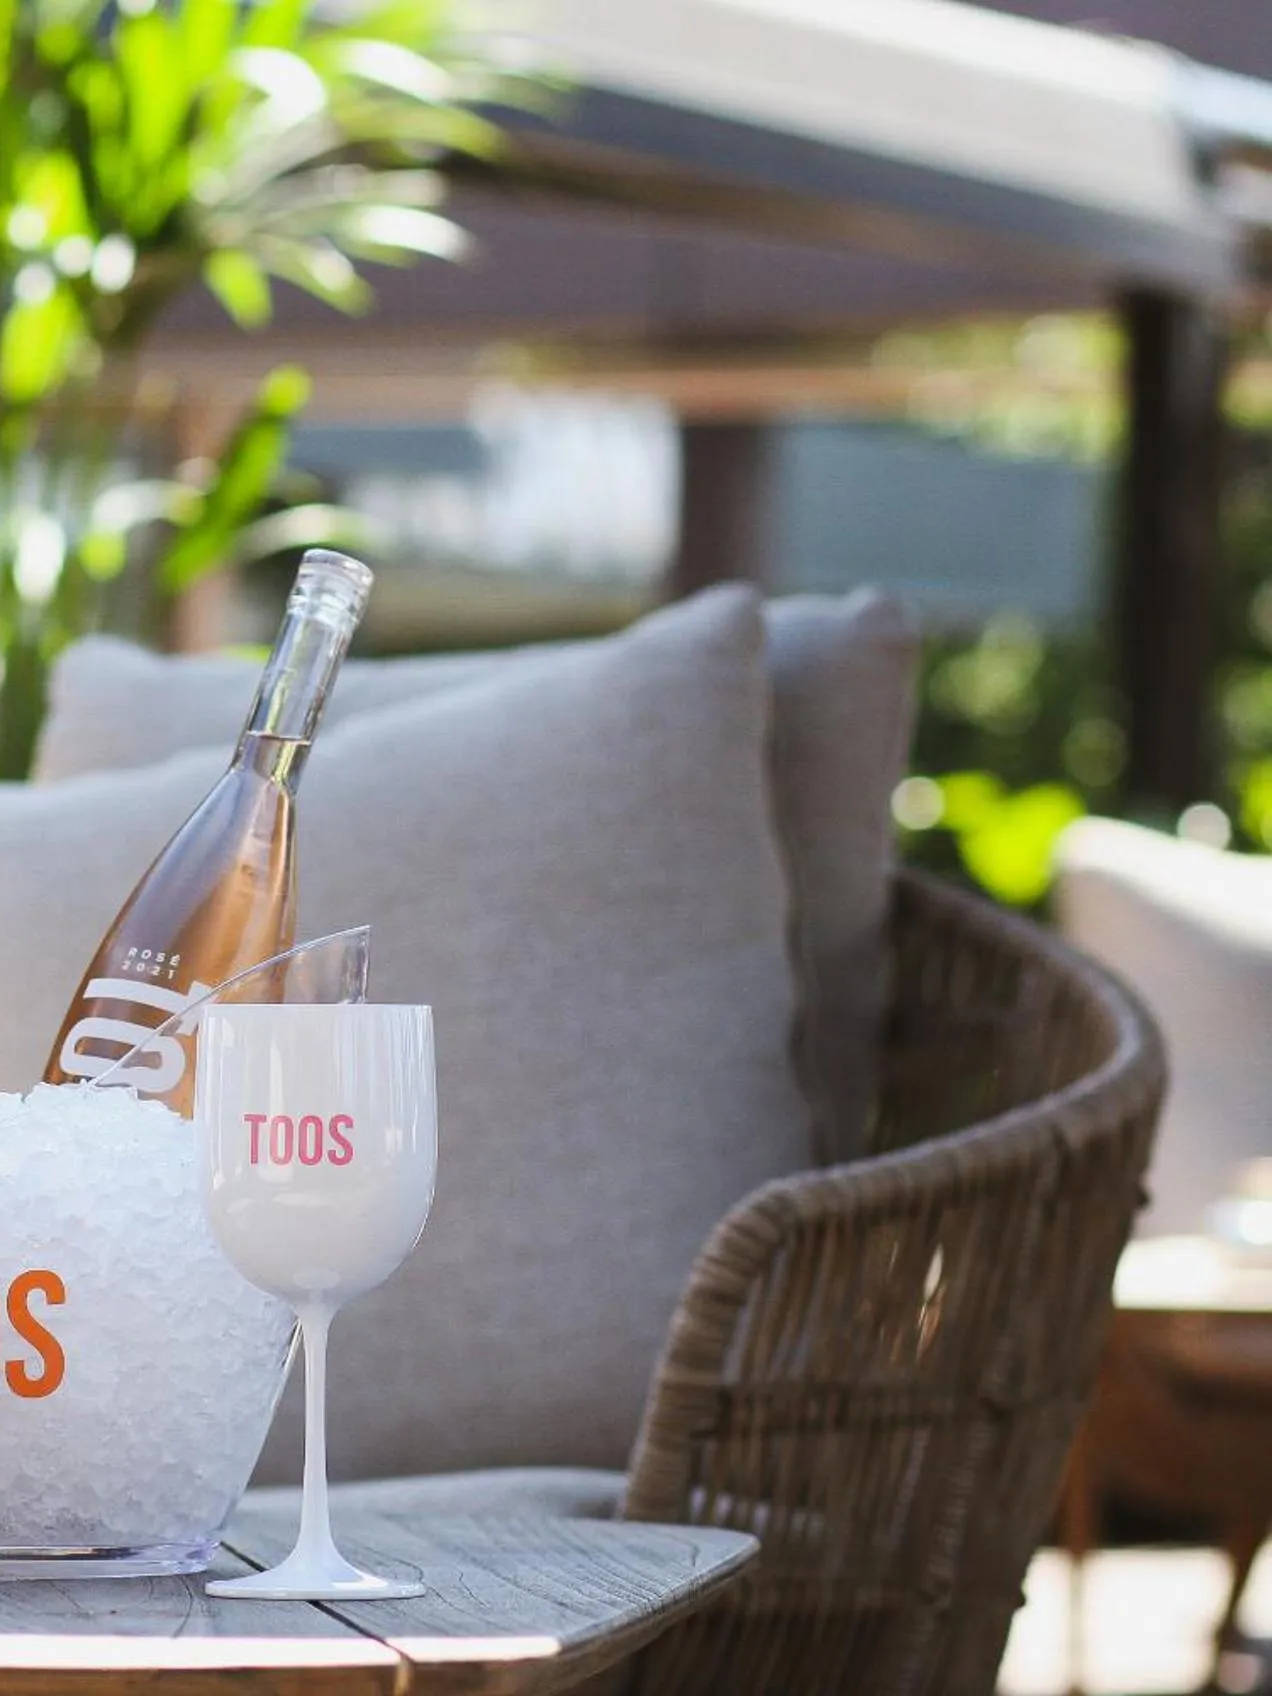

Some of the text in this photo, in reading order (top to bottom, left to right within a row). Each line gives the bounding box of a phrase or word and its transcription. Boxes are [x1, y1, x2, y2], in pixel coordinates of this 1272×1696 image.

[128, 947, 181, 967] ROSÉ
[121, 960, 177, 980] 2021
[244, 1114, 355, 1166] TOOS
